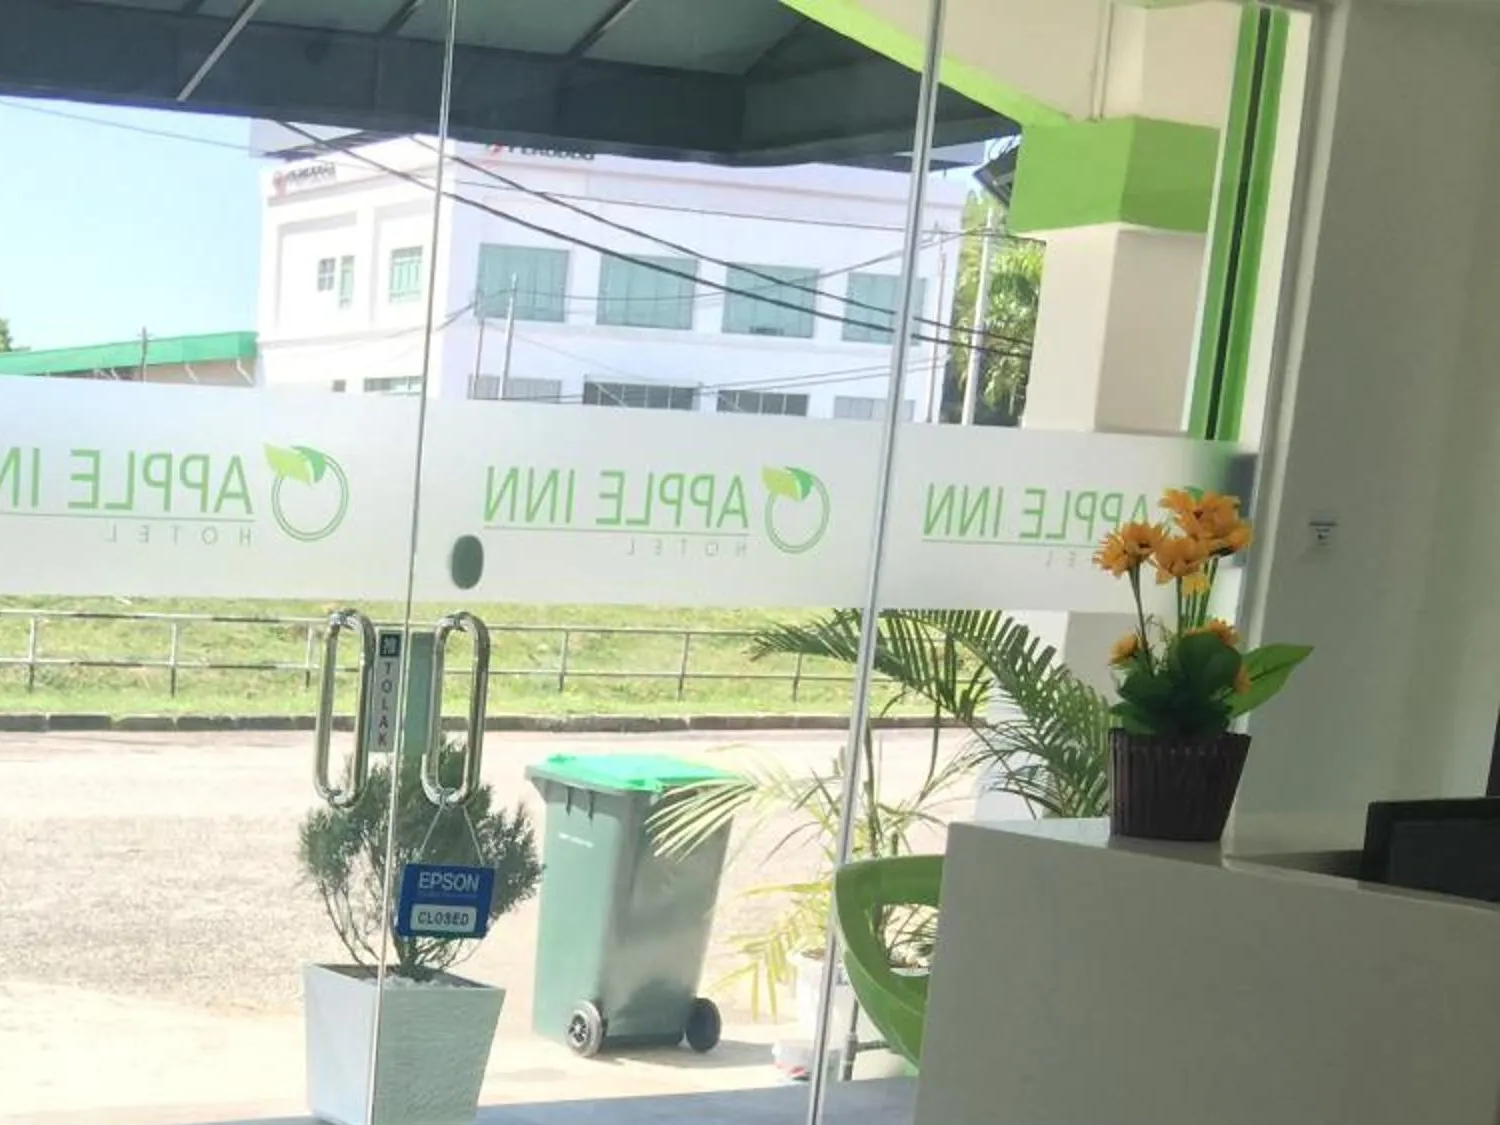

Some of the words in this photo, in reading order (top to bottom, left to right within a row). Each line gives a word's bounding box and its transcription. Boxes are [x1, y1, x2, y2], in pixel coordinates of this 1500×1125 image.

[376, 661, 393, 747] TOLAK
[418, 871, 481, 893] EPSON
[417, 911, 470, 927] CLOSED
